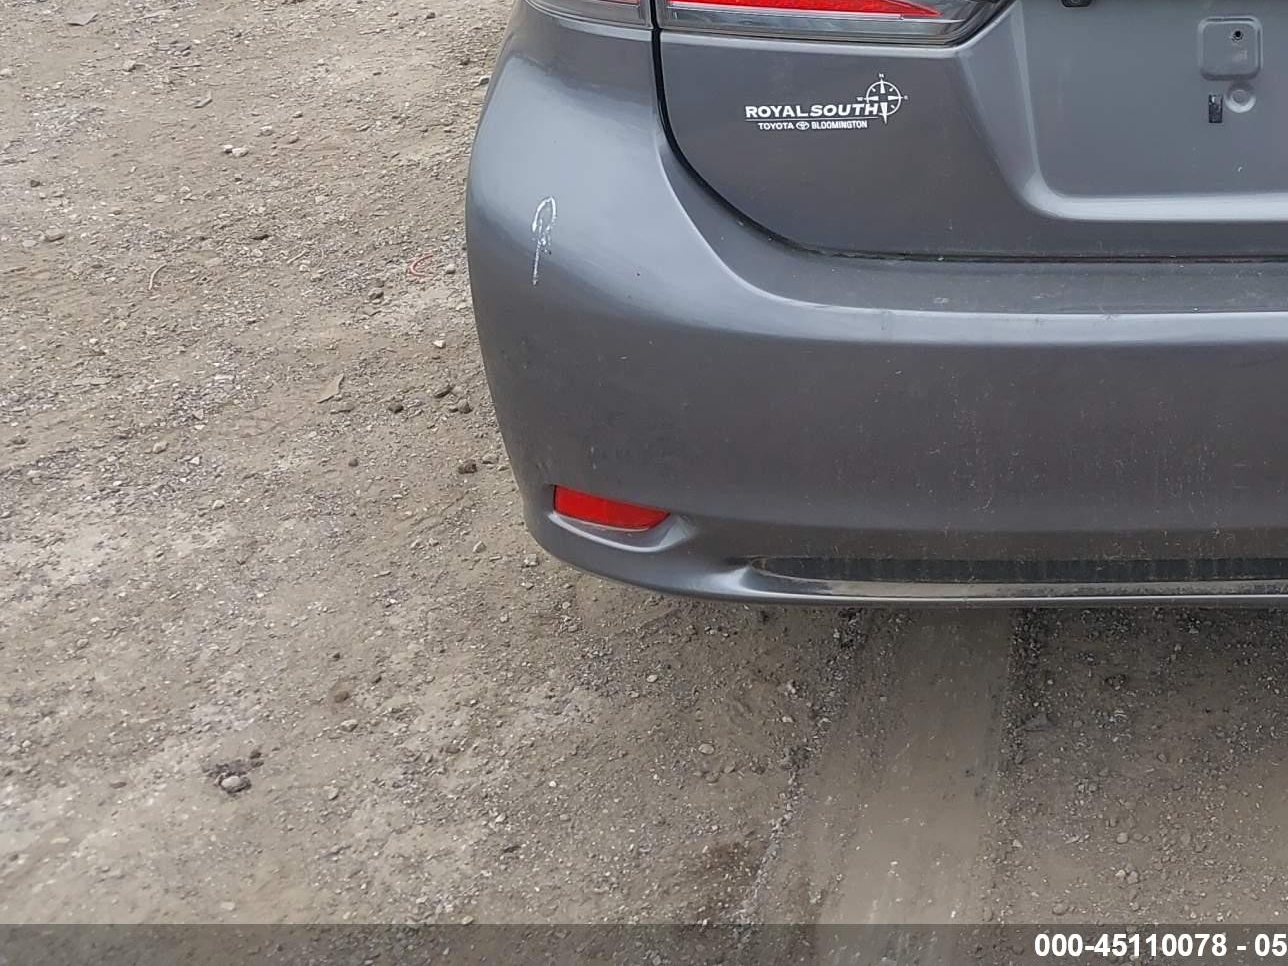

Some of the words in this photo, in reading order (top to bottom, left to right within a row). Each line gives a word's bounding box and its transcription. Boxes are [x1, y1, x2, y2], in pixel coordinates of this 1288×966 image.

[745, 105, 809, 118] ROYAL
[809, 103, 879, 117] SOUTH
[757, 121, 795, 131] TOYOTA
[811, 120, 868, 130] BLOOMINGTON
